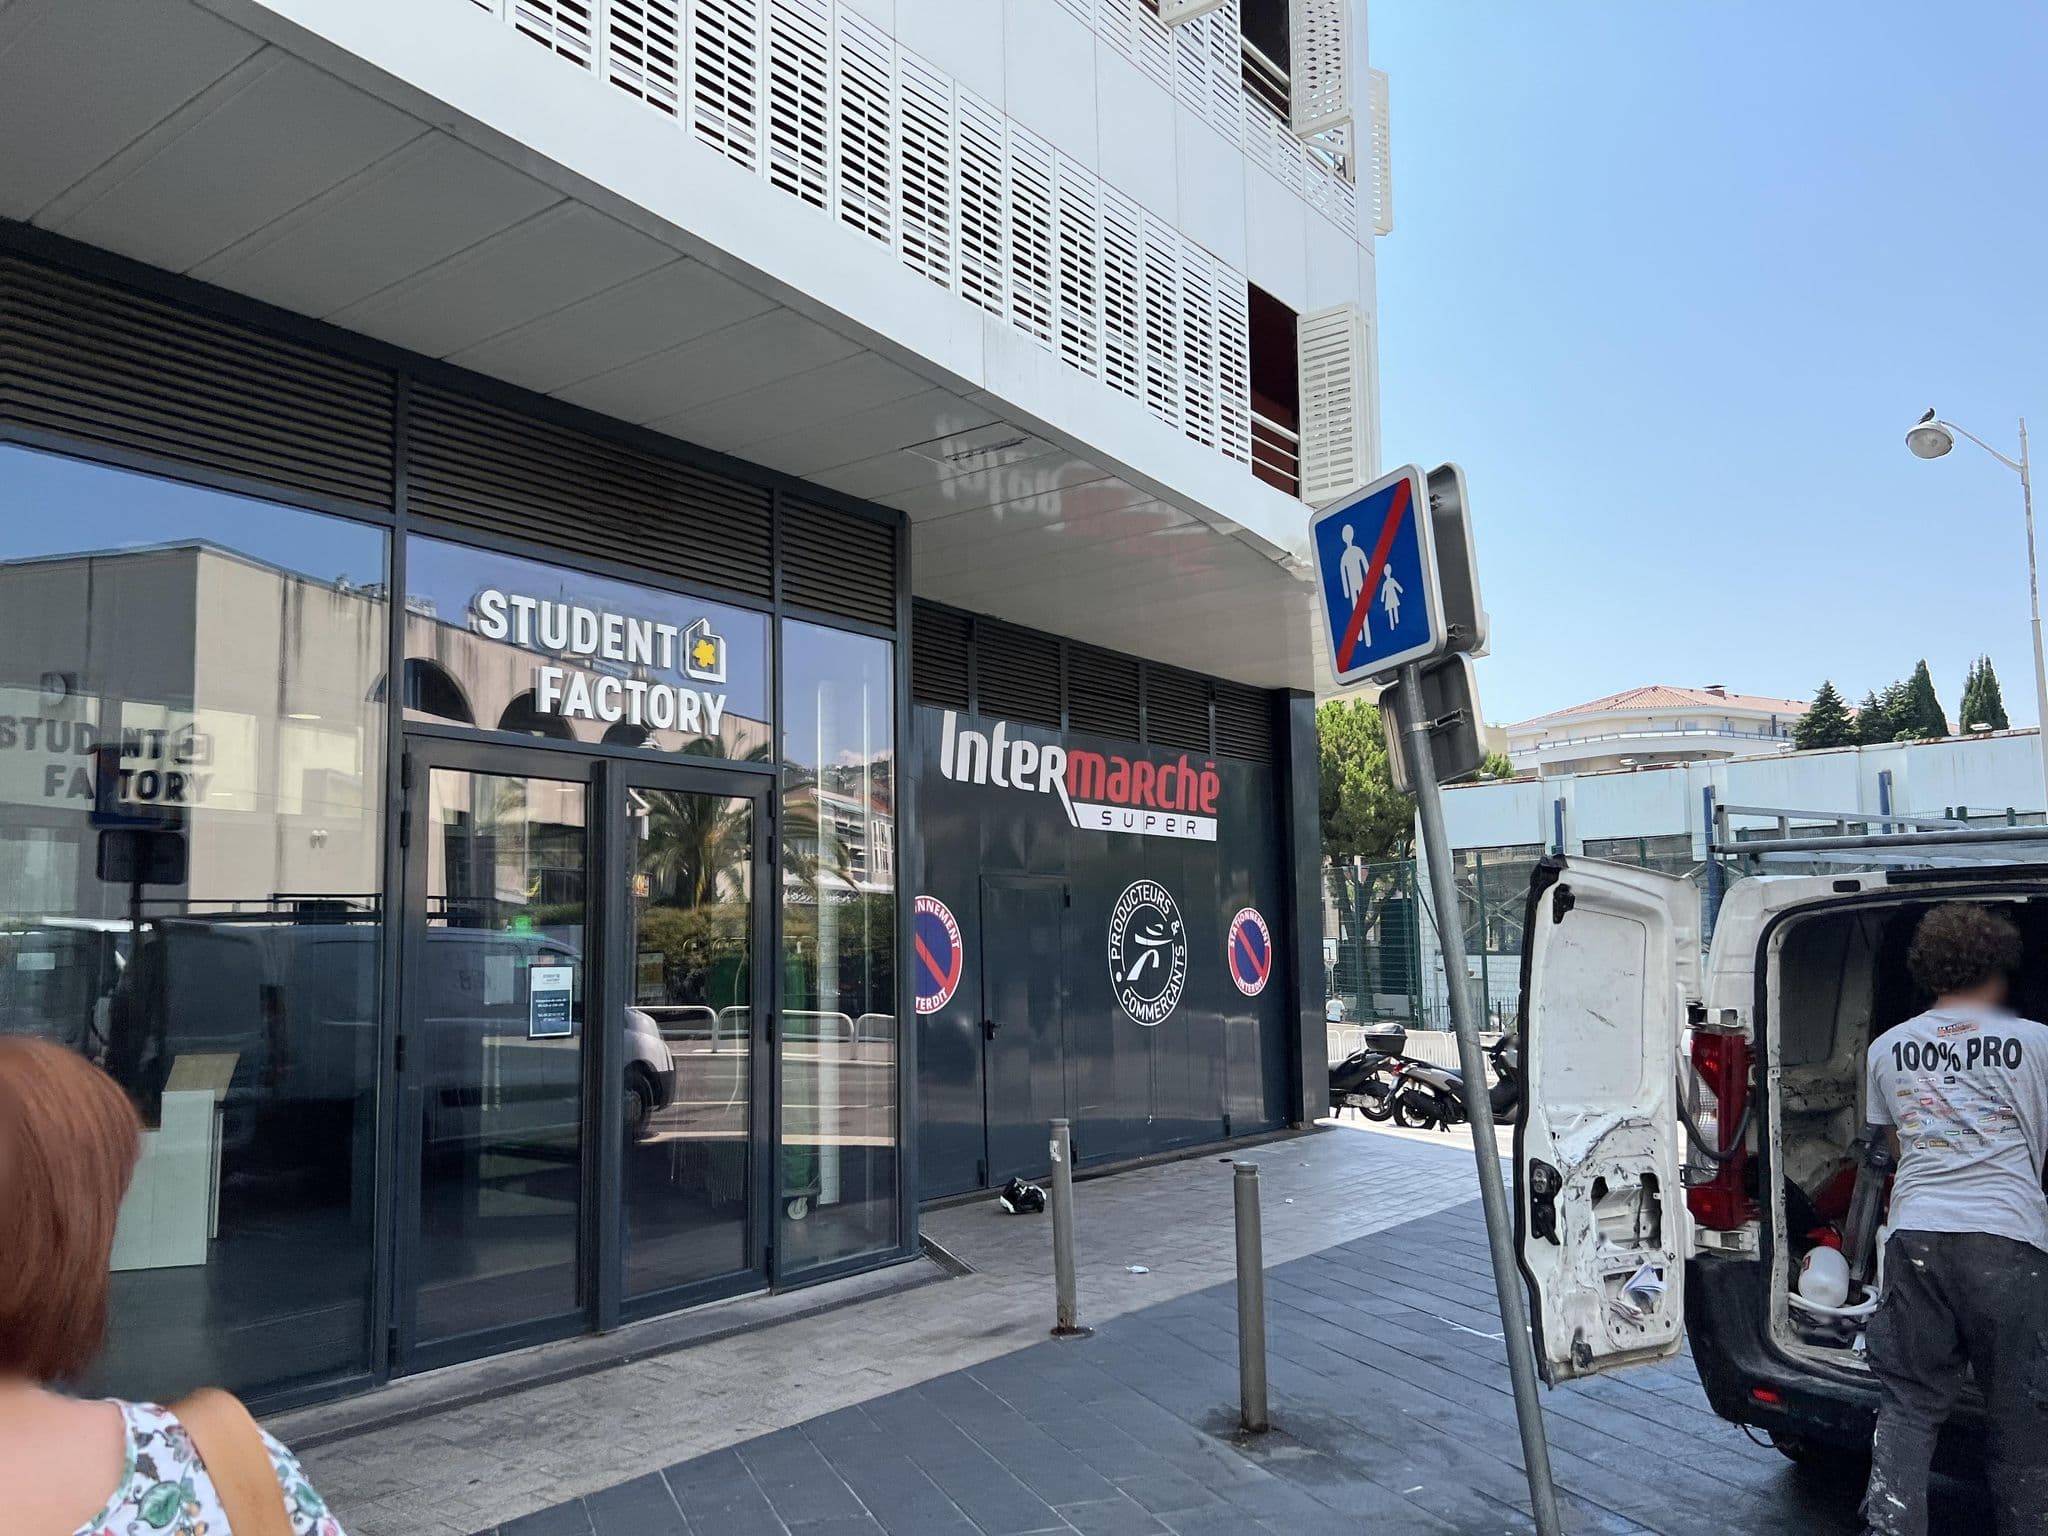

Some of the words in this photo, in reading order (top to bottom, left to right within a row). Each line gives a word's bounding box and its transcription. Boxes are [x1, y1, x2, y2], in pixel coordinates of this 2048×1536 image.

[477, 589, 678, 668] STUDENT
[536, 666, 727, 735] FACTORY
[44, 764, 215, 801] FATORY
[1101, 810, 1198, 835] SUPER
[1111, 884, 1173, 960] PRODUCTEURS
[1170, 919, 1180, 936] &
[1229, 909, 1271, 949] STATIONNEMENT
[1122, 944, 1185, 1021] COMMERÇANTS
[1237, 975, 1264, 994] INTERDIT
[1891, 1041, 1961, 1073] 100%
[1966, 1035, 2023, 1072] PRO
